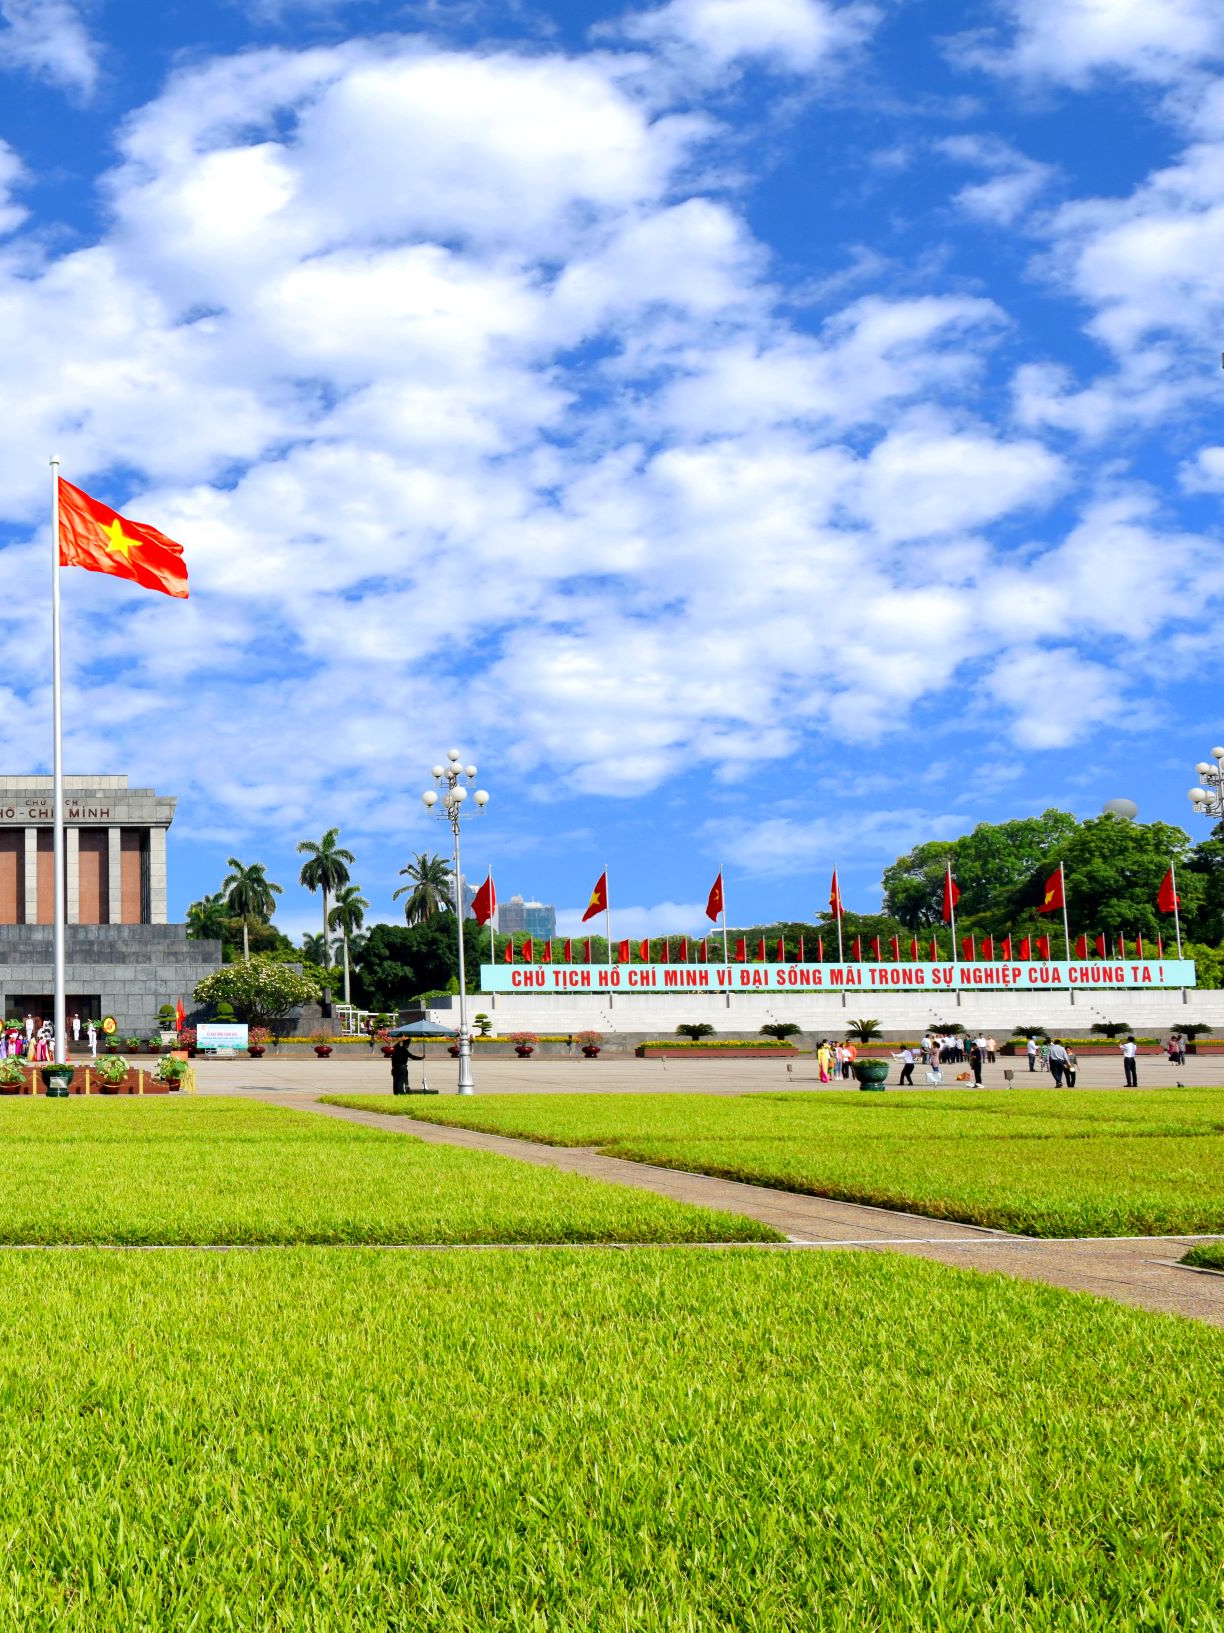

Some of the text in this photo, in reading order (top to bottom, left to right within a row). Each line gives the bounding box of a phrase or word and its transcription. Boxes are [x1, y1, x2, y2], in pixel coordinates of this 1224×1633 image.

[512, 966, 545, 987] CHỦ
[553, 970, 591, 989] TỊCH
[599, 965, 620, 987] HỒ
[628, 967, 657, 987] CHÍ
[664, 970, 708, 987] MINH
[717, 967, 733, 986] VĨ
[740, 969, 769, 988] ĐẠI
[777, 964, 822, 986] SỐNG
[829, 965, 862, 985] MÃI
[869, 968, 925, 985] TRONG
[932, 965, 954, 987] SỰ
[960, 964, 1022, 987] NGHIỆP
[1028, 962, 1061, 983] CỦA
[1068, 963, 1124, 983] CHÚNG
[1131, 966, 1152, 983] TA
